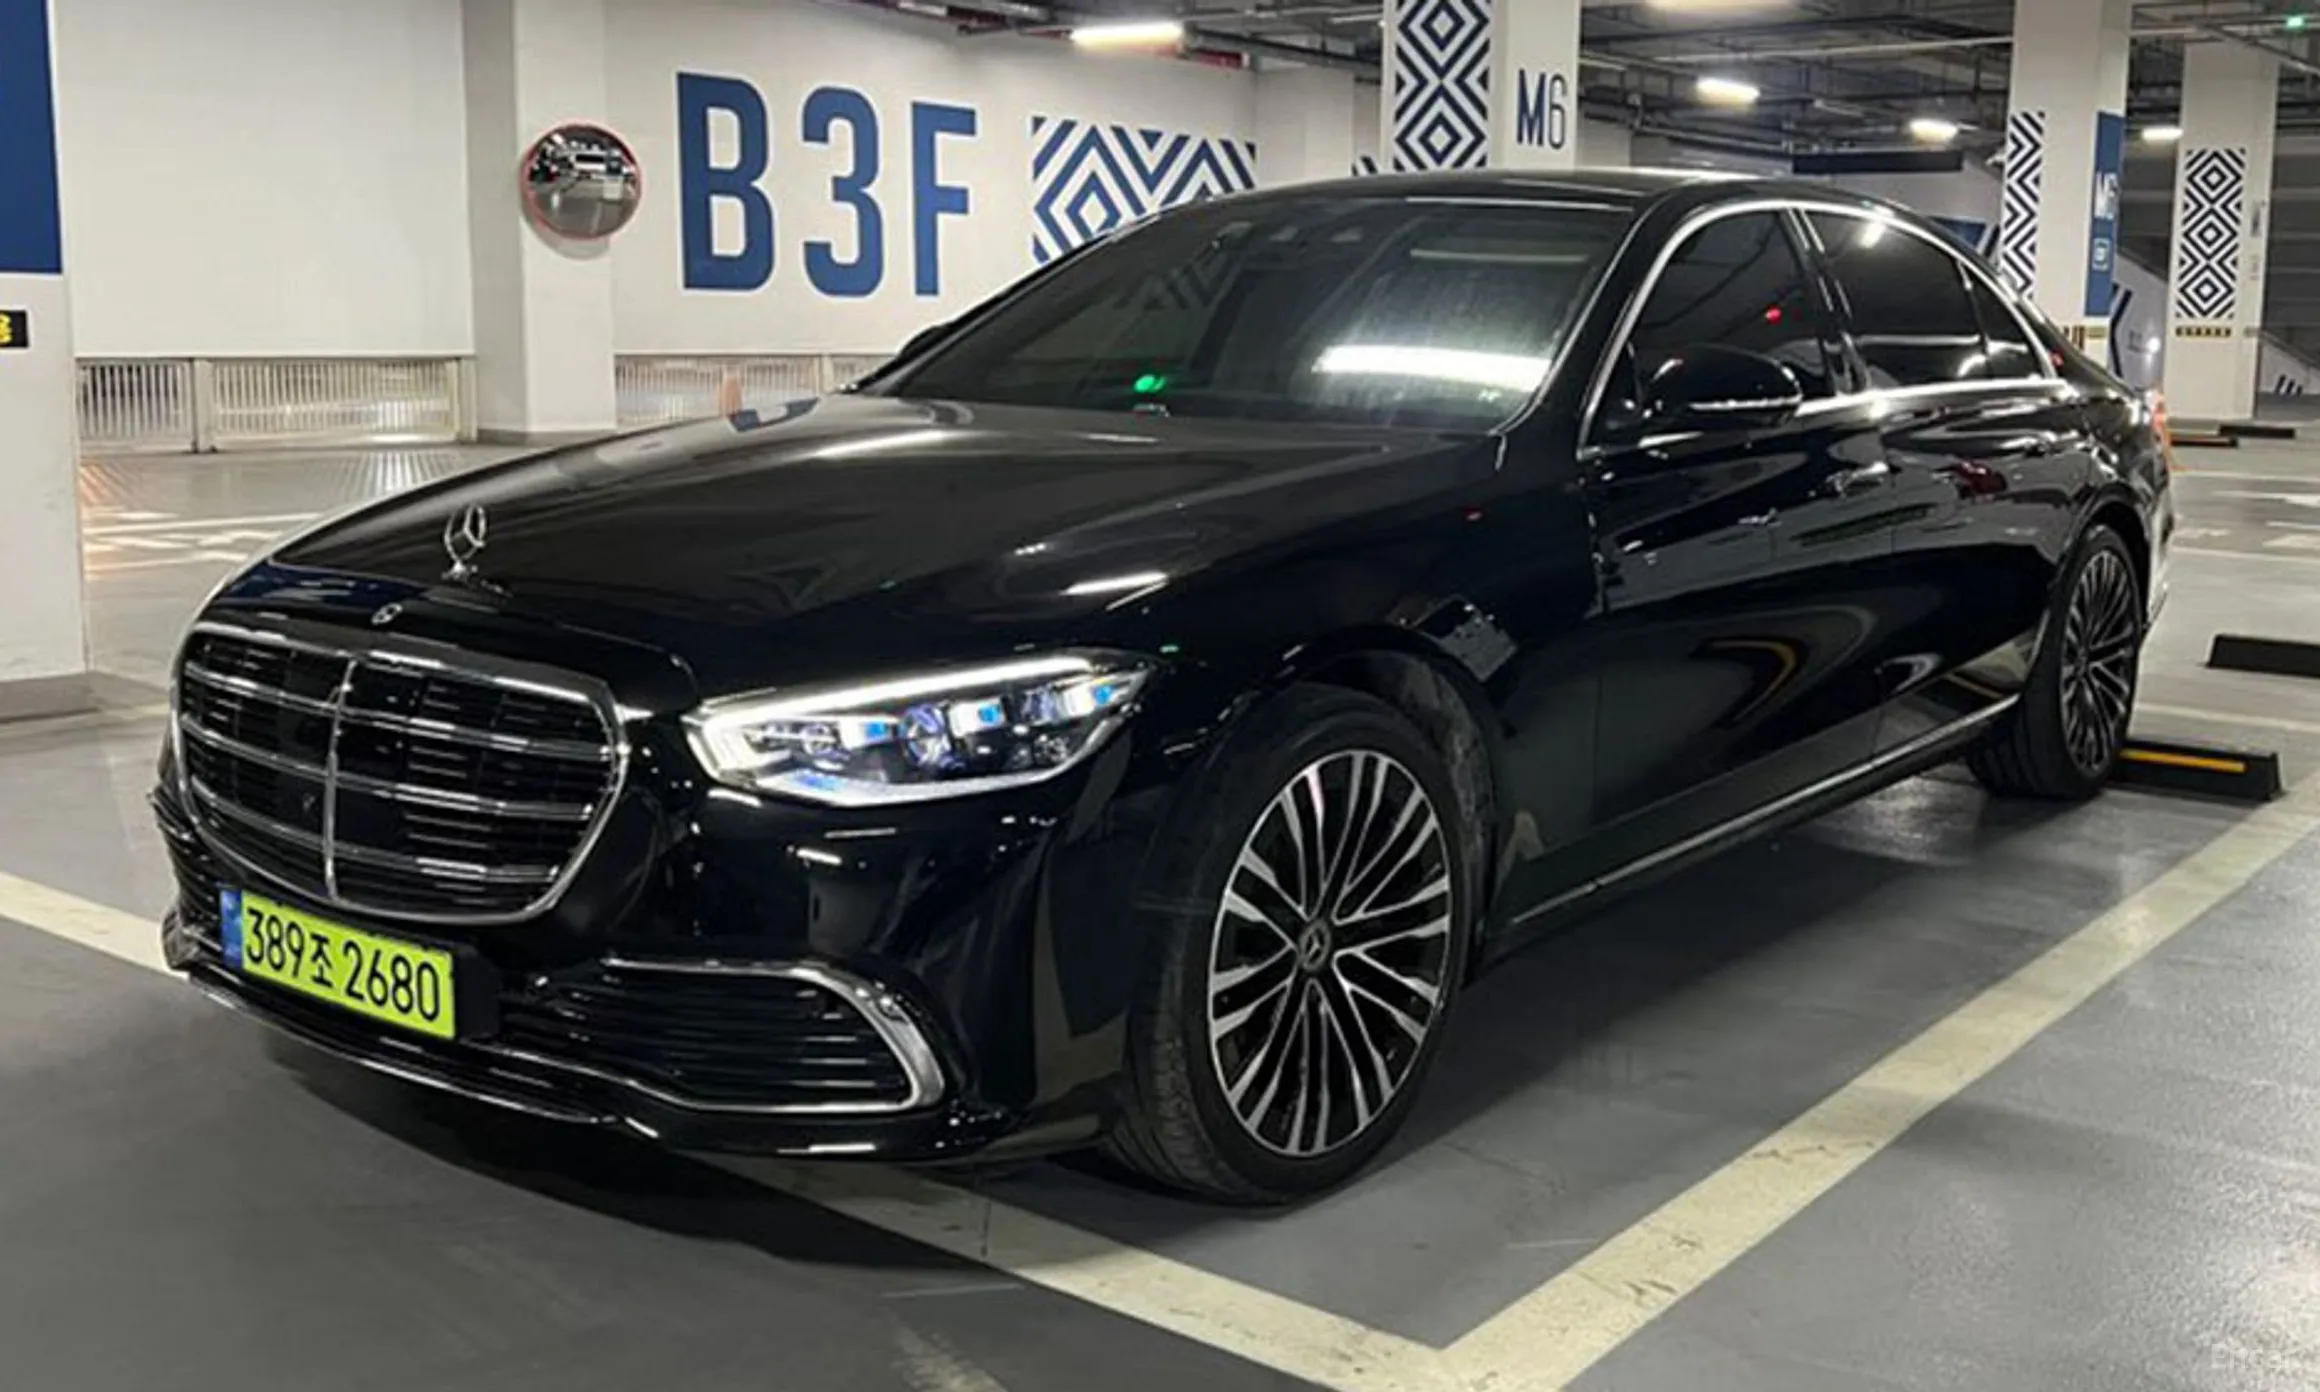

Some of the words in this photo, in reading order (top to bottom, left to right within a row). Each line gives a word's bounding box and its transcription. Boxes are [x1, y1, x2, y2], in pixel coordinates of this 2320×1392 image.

[1517, 68, 1568, 150] M6
[677, 71, 976, 298] B3F
[246, 906, 333, 988] 389조
[342, 939, 440, 1022] 2680
